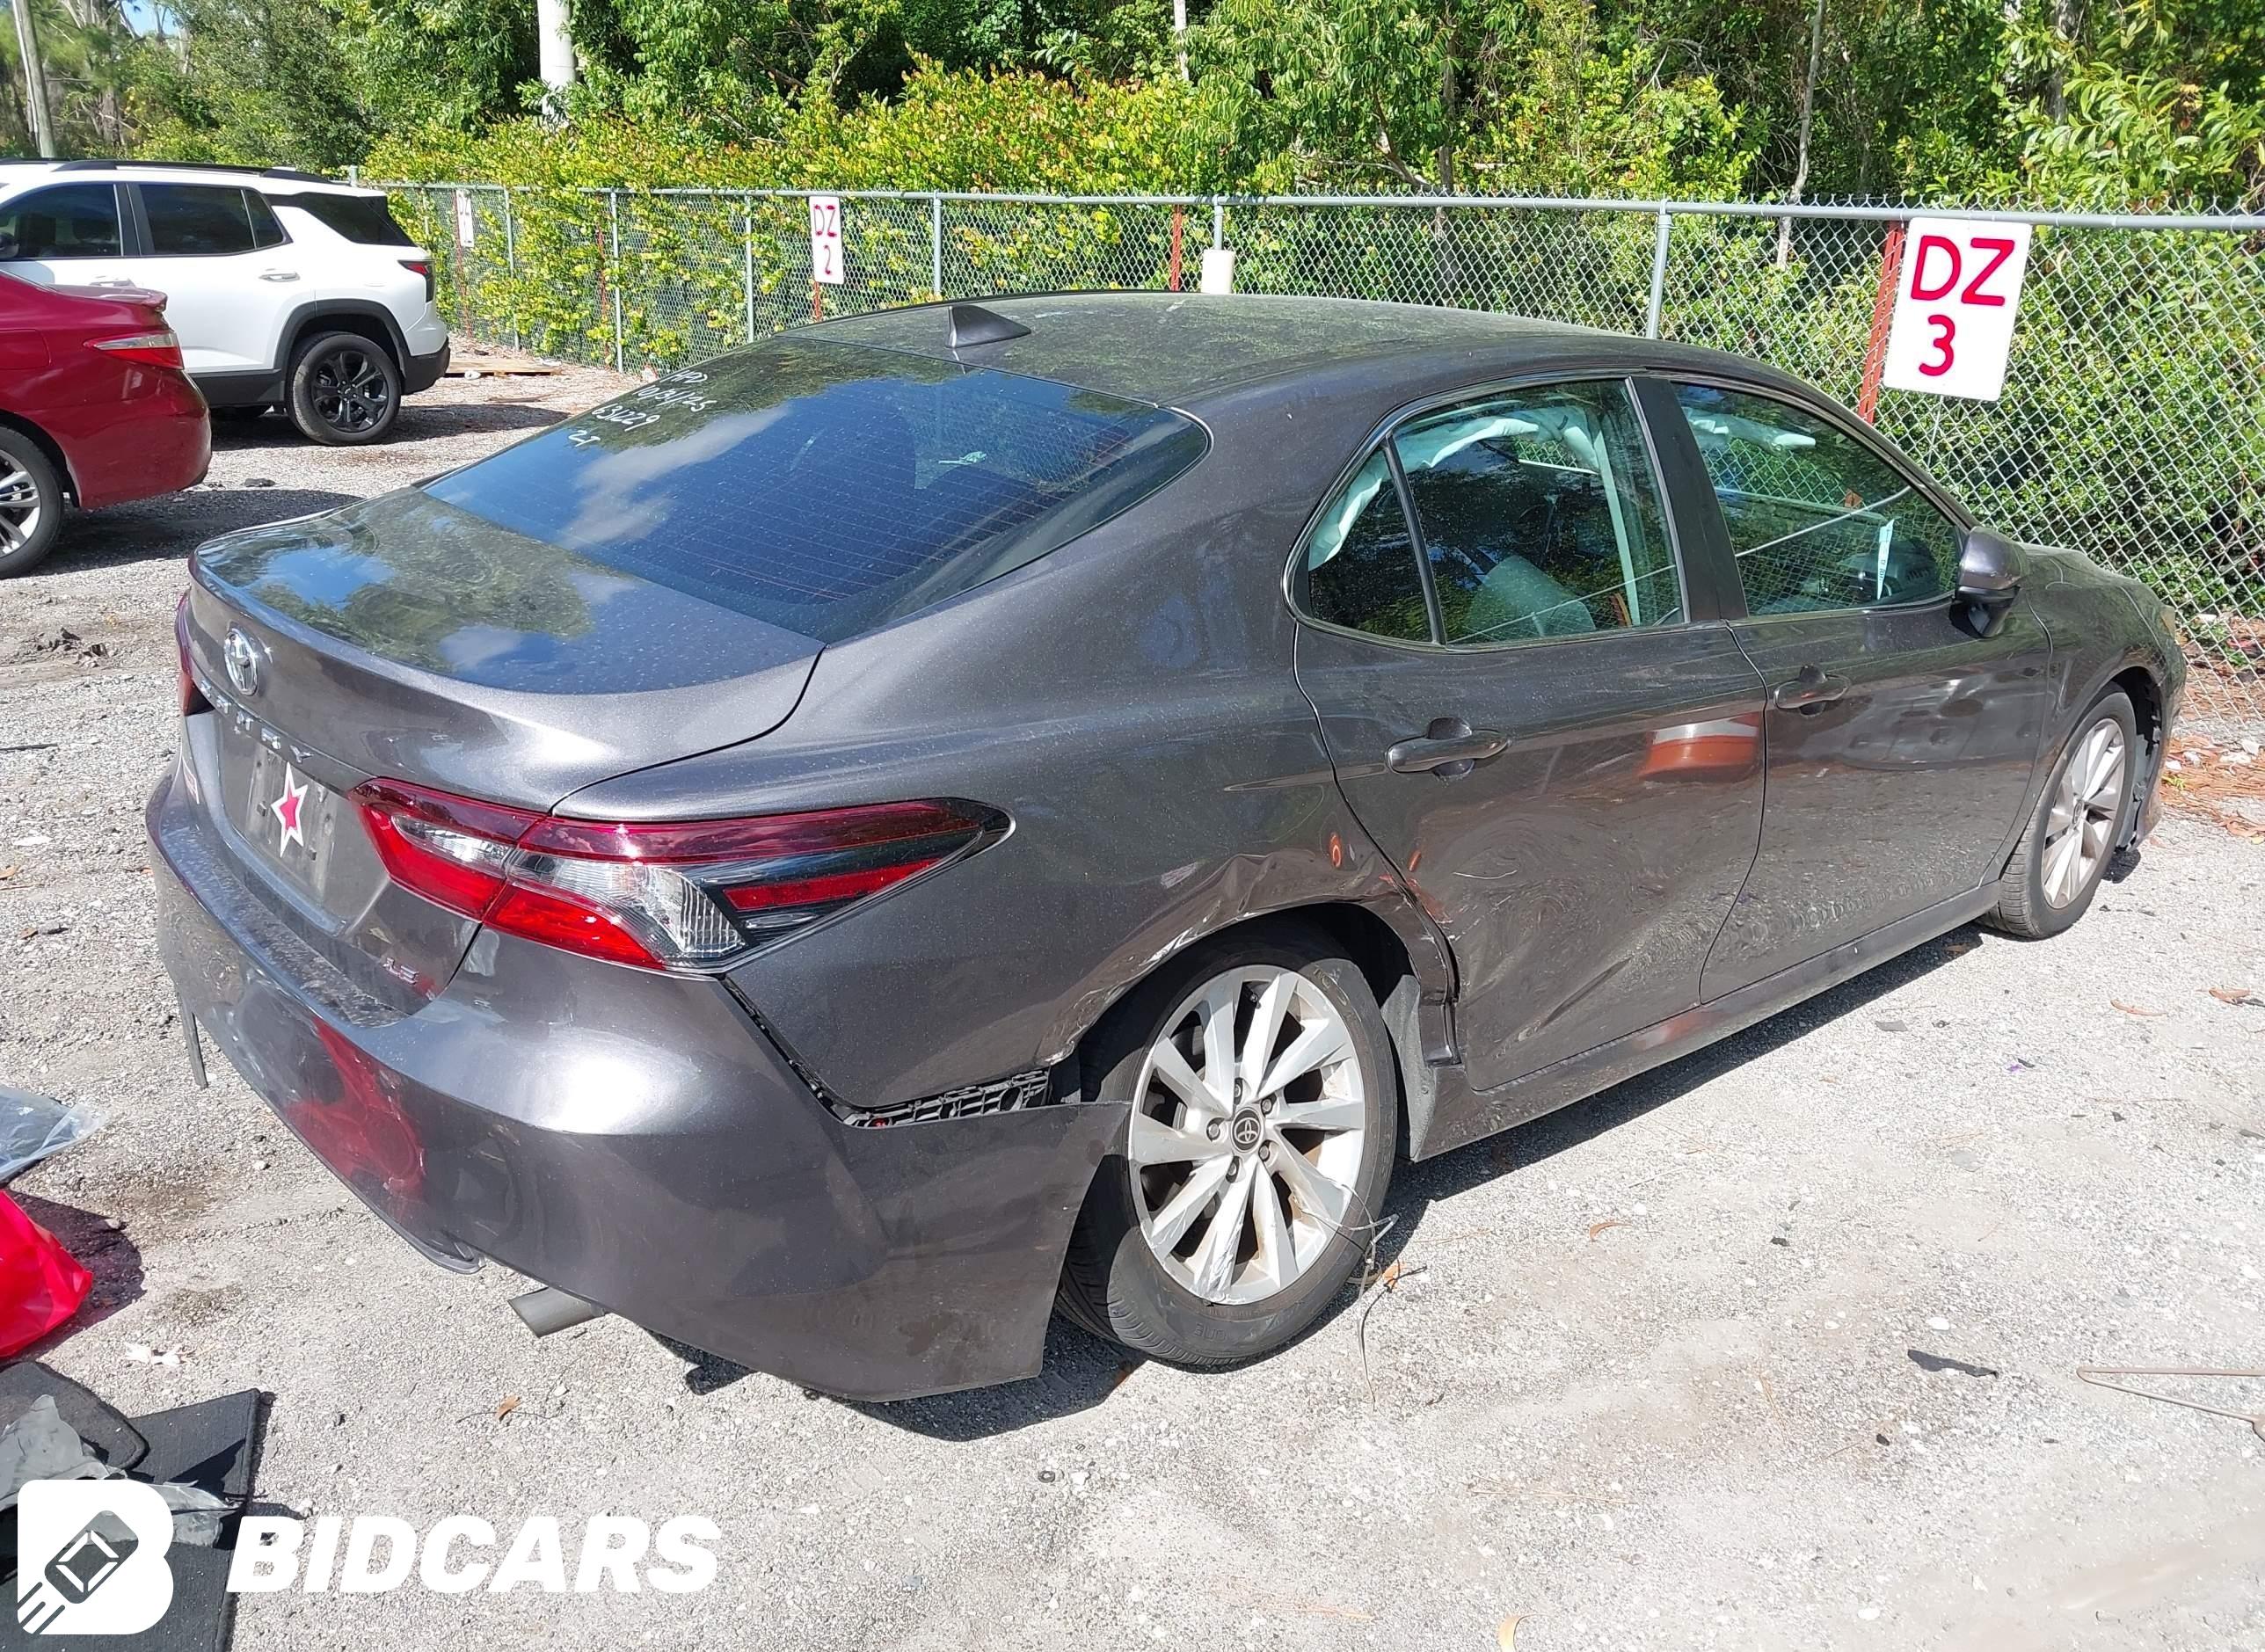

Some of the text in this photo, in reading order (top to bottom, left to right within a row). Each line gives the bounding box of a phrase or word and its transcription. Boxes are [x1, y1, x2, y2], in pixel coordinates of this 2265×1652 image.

[813, 204, 837, 237] DZ
[824, 244, 832, 275] 2
[1910, 235, 2015, 307] DZ
[1919, 314, 1955, 376] 3
[592, 404, 660, 432] 631229
